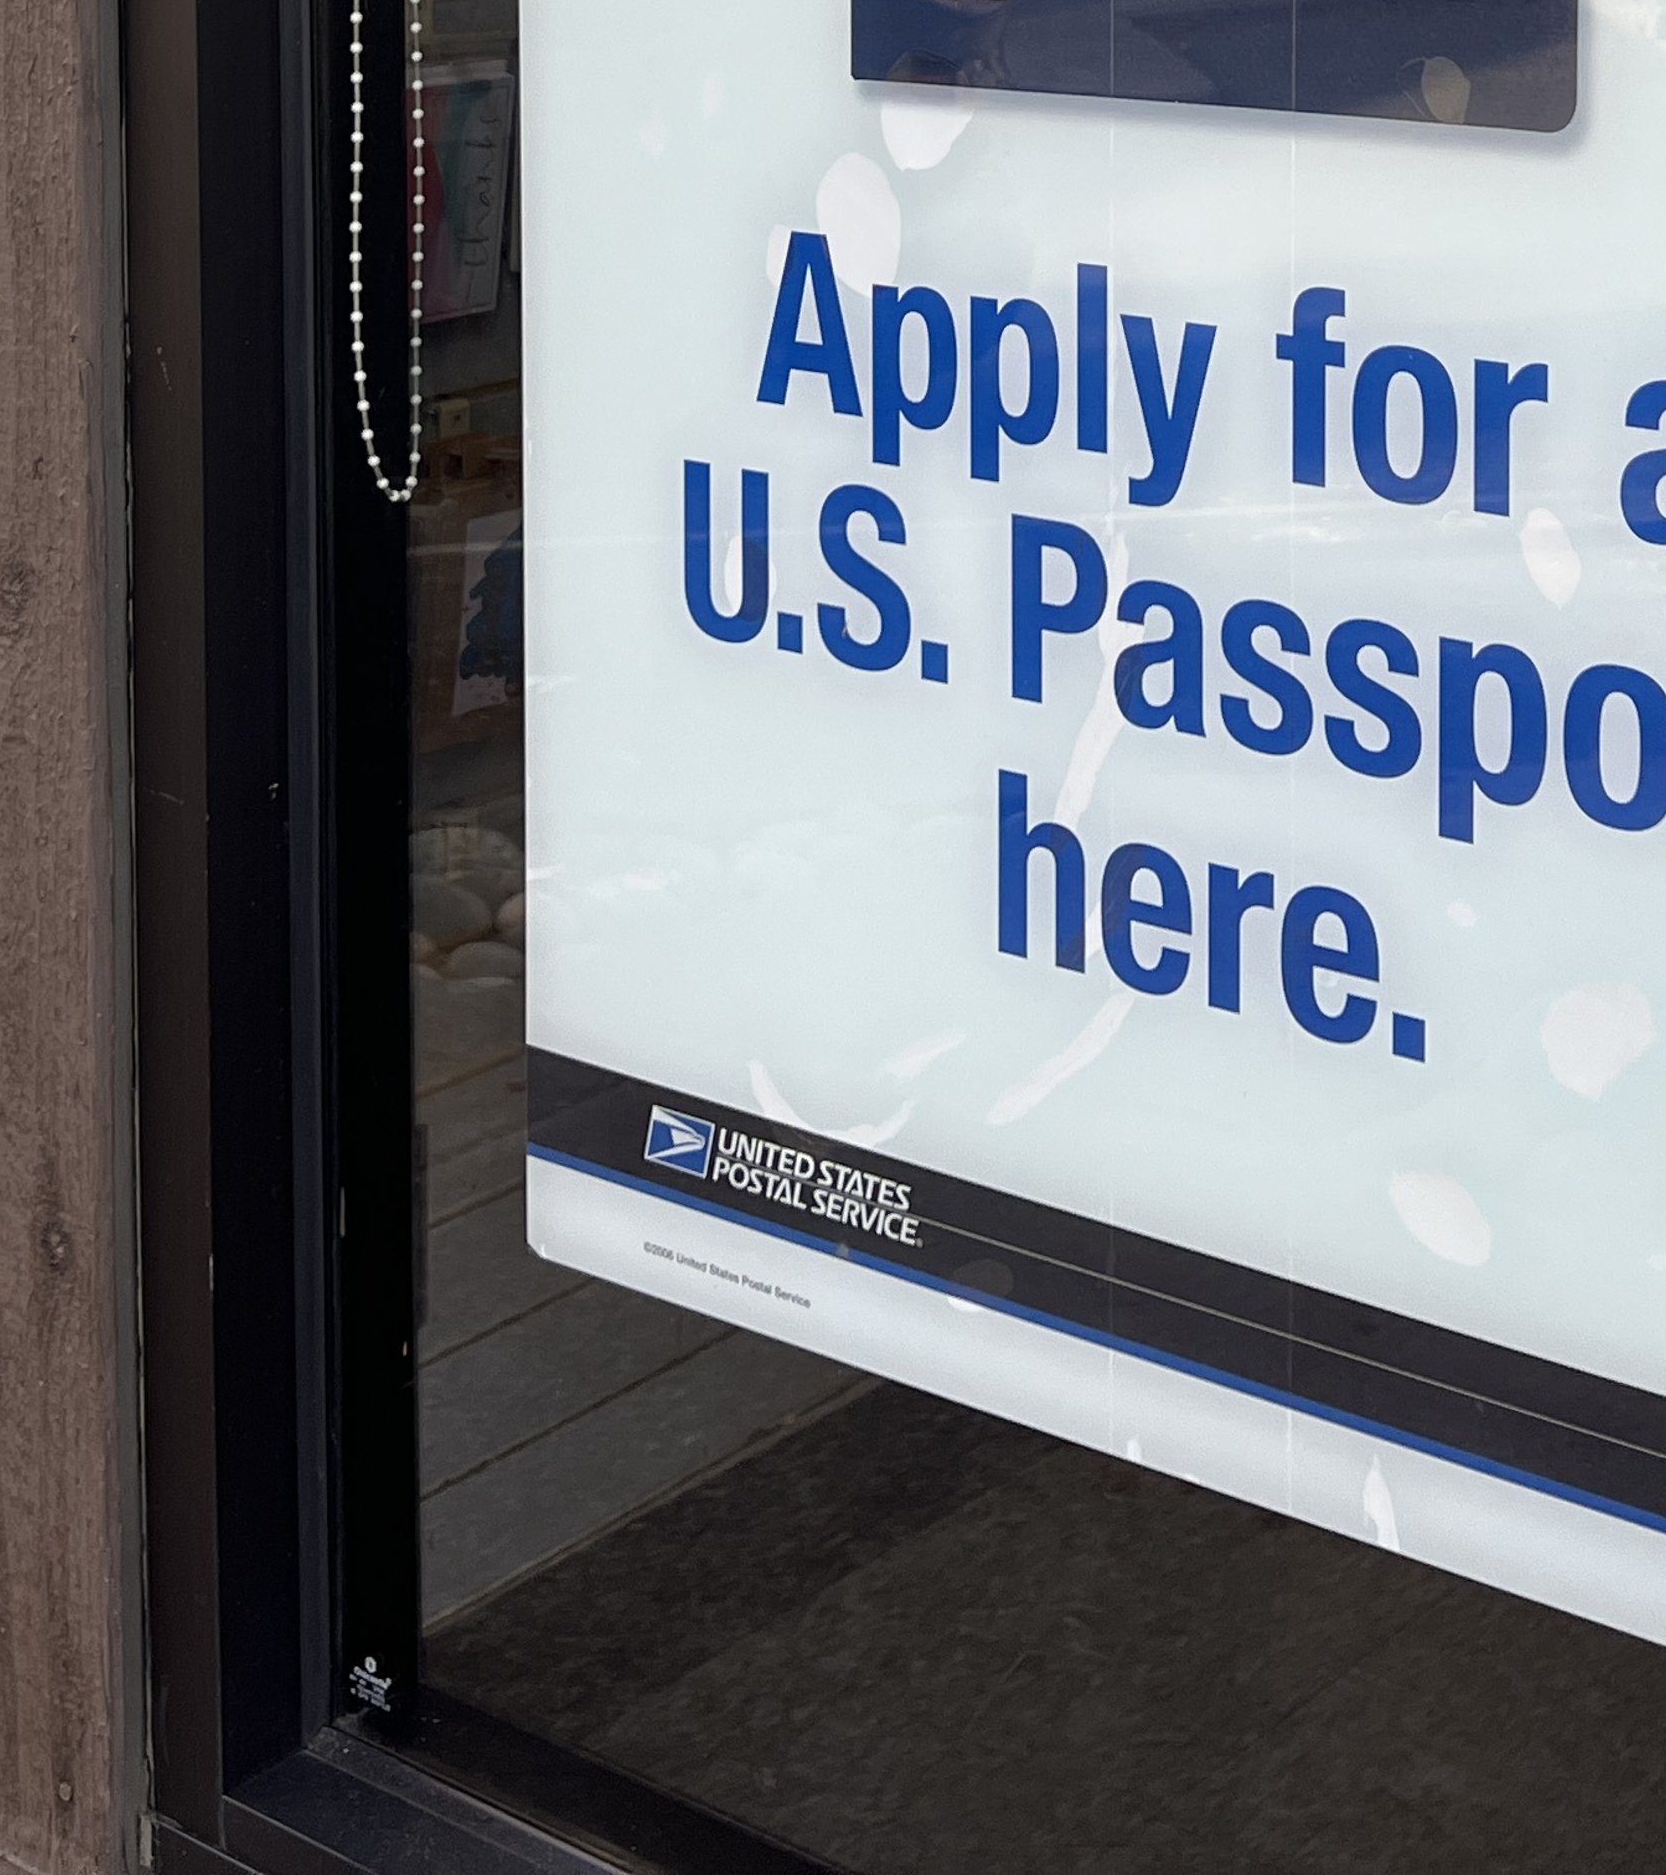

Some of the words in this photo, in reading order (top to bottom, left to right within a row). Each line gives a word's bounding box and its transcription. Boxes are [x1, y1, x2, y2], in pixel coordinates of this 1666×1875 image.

[755, 229, 1218, 508] Apply
[1274, 286, 1549, 518] for
[682, 460, 950, 684] U.S.
[997, 768, 1427, 1064] here.
[711, 1155, 808, 1211] POSTAL
[717, 1126, 816, 1180] UNITED
[816, 1159, 913, 1212] STATES
[676, 1251, 708, 1274] United
[709, 1263, 740, 1285] States
[741, 1274, 772, 1295] Postal
[774, 1285, 812, 1309] Service
